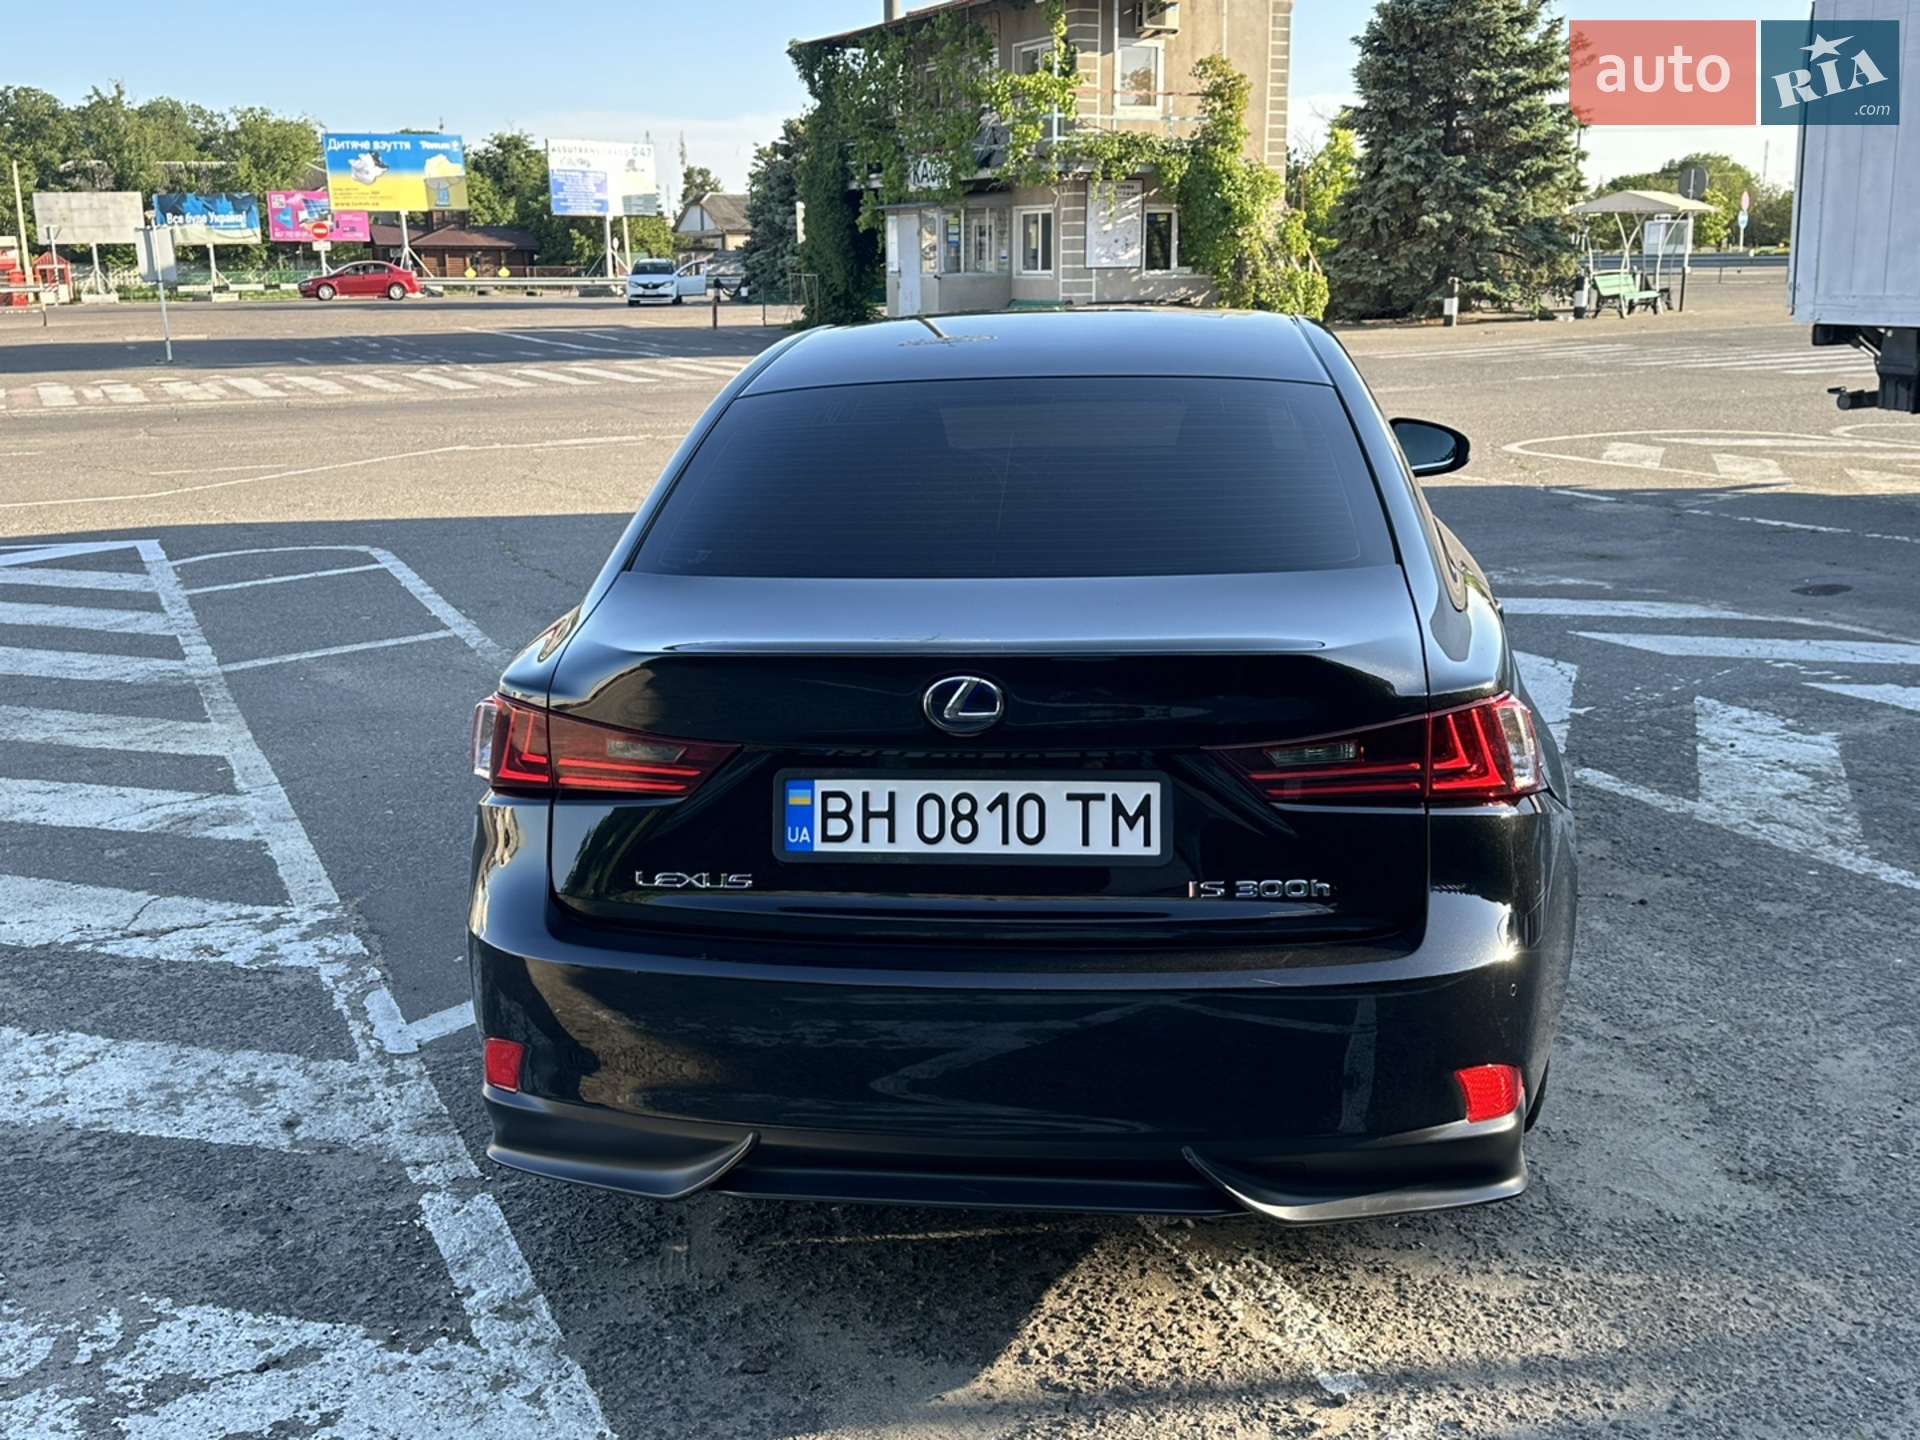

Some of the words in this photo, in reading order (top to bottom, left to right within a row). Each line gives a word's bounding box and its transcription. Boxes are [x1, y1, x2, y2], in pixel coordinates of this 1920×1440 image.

[327, 138, 370, 152] Дитяче
[373, 140, 411, 153] взуття
[631, 146, 652, 157] 047
[166, 212, 184, 225] Все
[185, 211, 207, 225] буде
[208, 210, 246, 226] Україна!
[820, 791, 896, 844] BH
[916, 792, 1046, 846] 0810
[1066, 793, 1152, 847] TM
[788, 827, 811, 843] UA
[635, 871, 753, 889] LEXUS
[1188, 880, 1225, 898] IS
[1235, 879, 1331, 898] 300h
